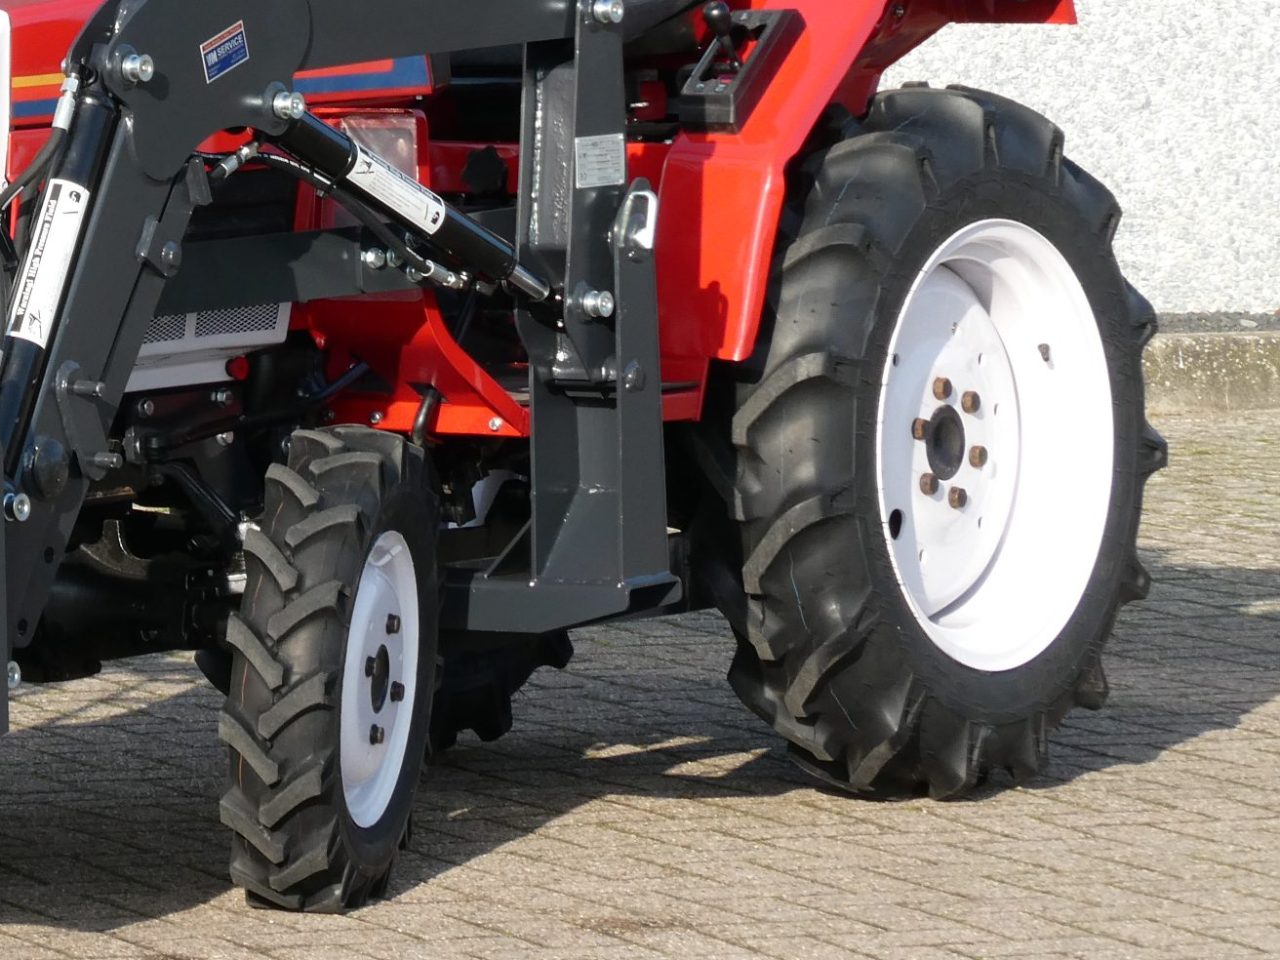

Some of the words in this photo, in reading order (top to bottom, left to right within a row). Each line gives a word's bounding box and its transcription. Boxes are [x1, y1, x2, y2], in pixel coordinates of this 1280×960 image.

[217, 33, 244, 57] SERVICE
[33, 222, 51, 256] Pressure
[27, 257, 40, 277] High
